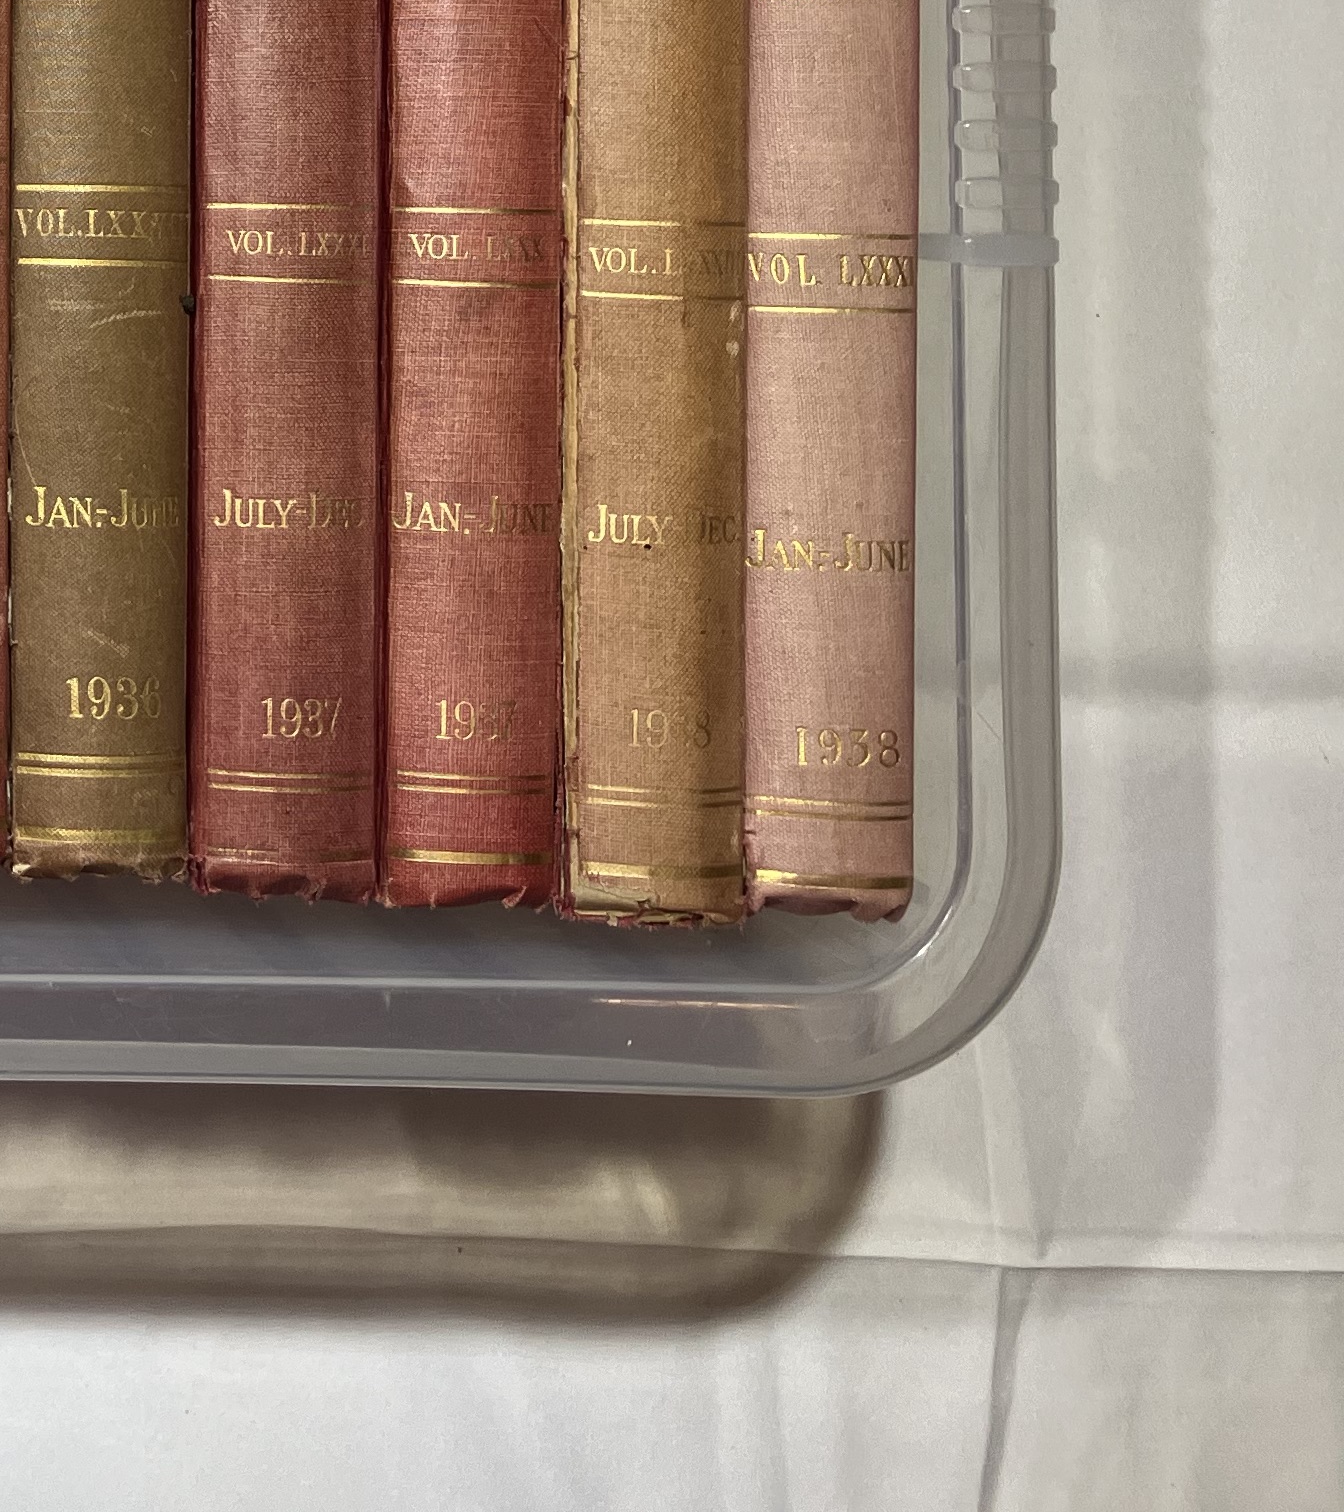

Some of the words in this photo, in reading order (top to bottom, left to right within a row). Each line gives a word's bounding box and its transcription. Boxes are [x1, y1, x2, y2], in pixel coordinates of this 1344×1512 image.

[14, 208, 83, 238] VOL.
[227, 230, 293, 257] VOL.
[408, 233, 477, 260] VOL.
[588, 247, 658, 274] VOL.
[66, 676, 161, 720] 1936
[261, 696, 343, 739] 1937
[629, 708, 711, 749] 198
[796, 725, 901, 769] 1938
